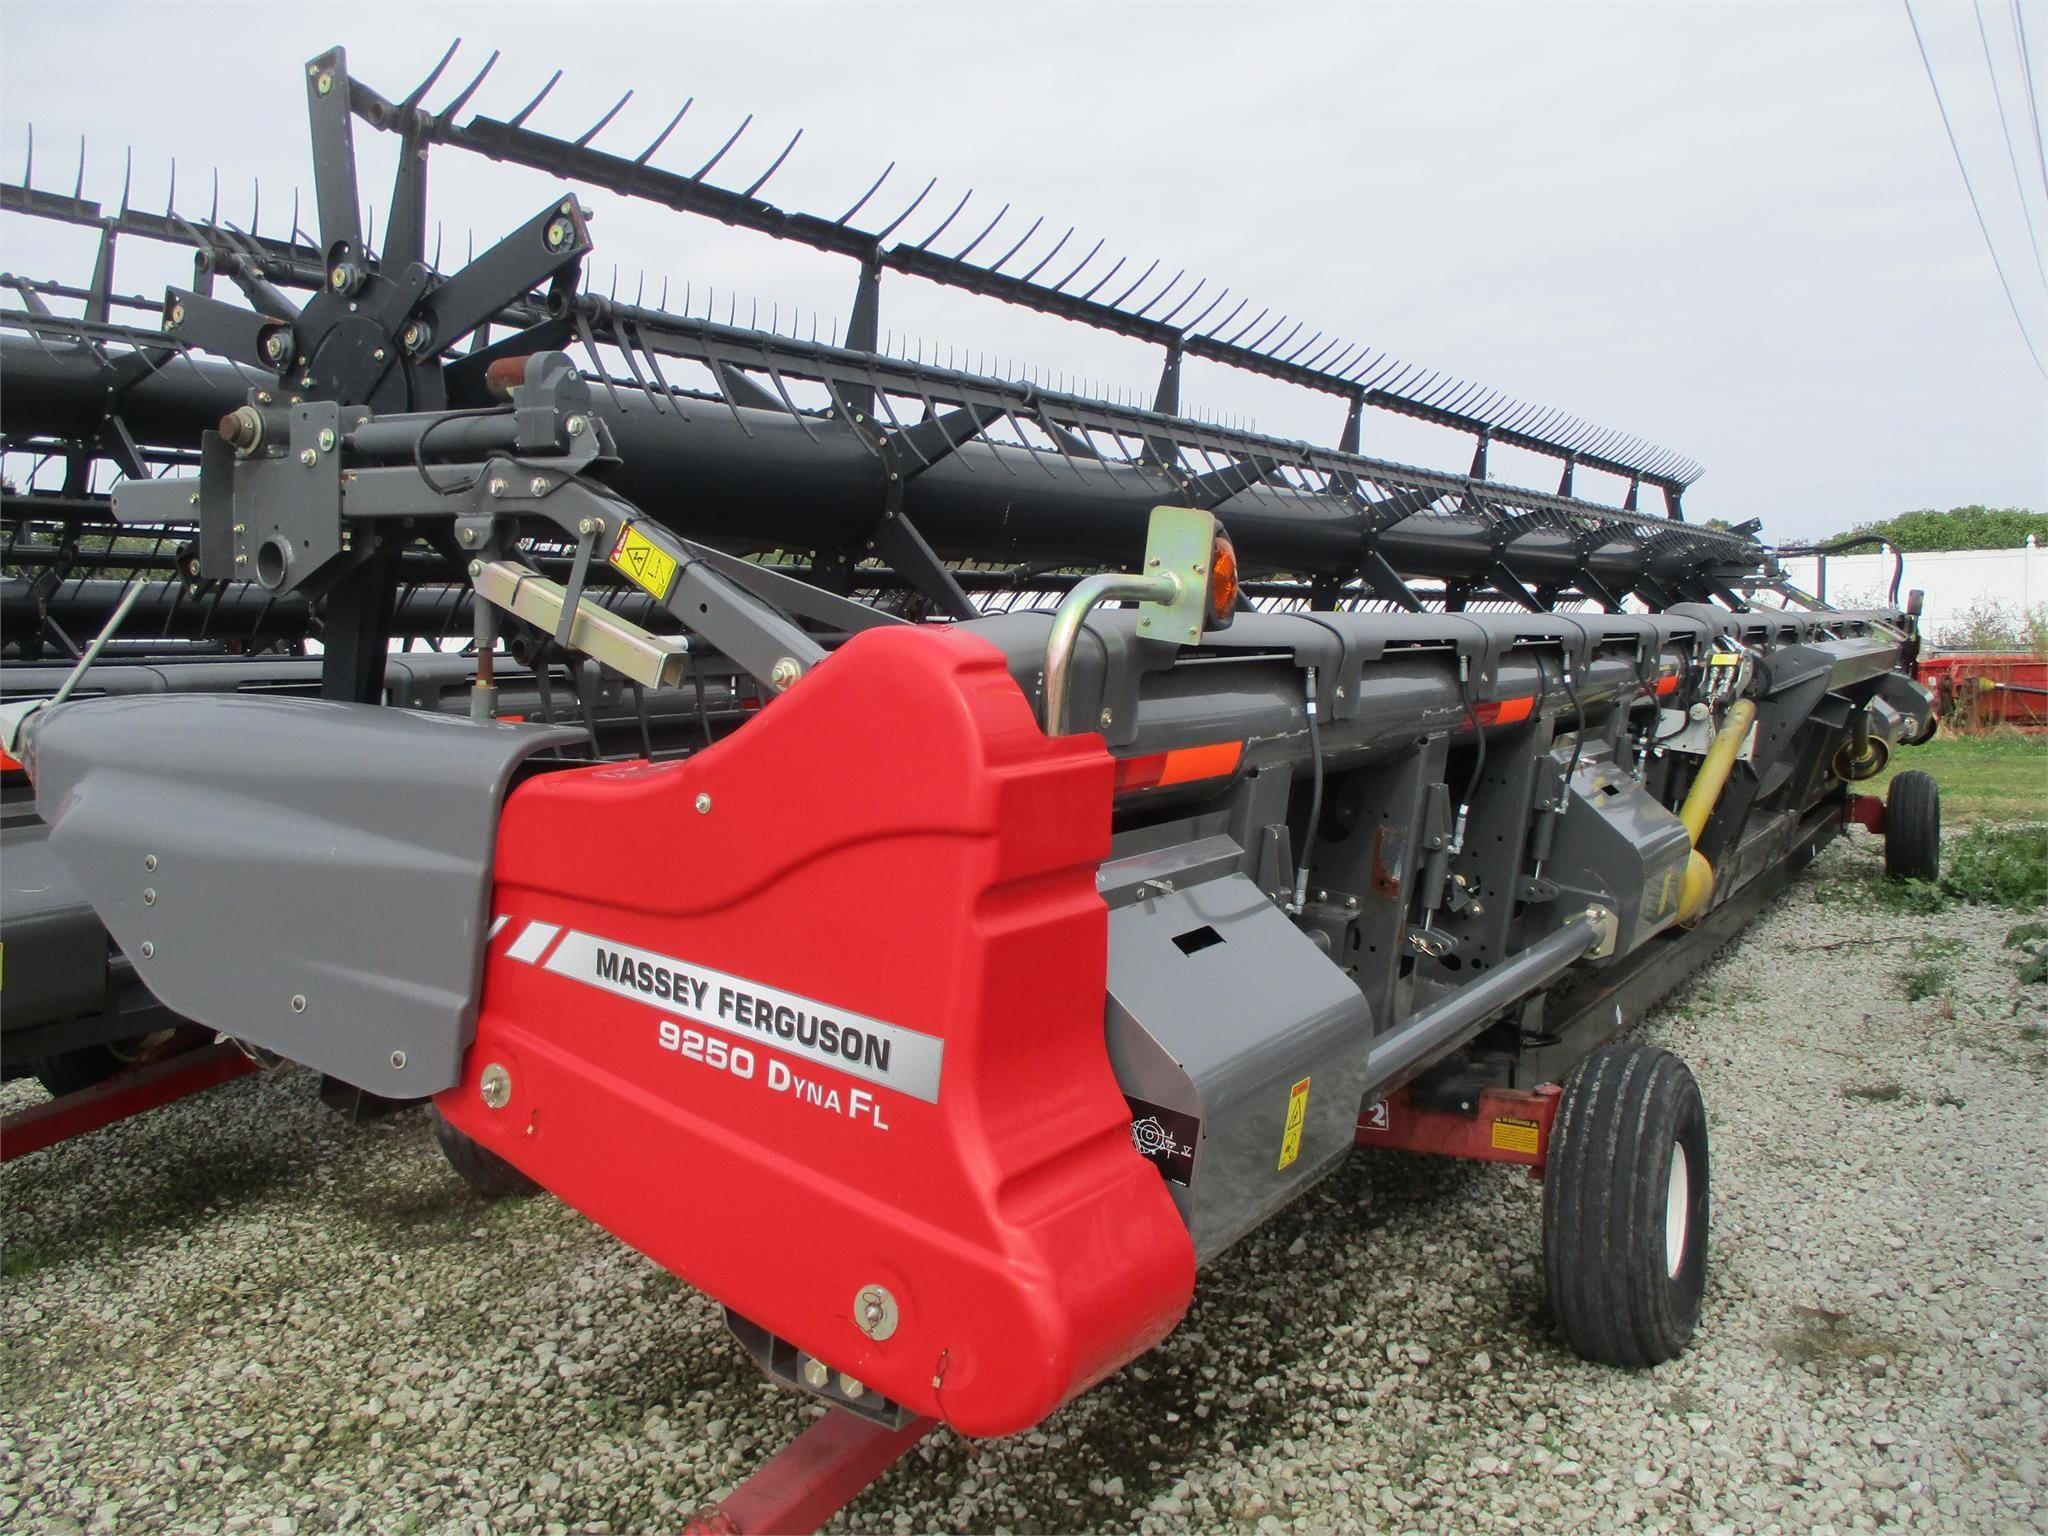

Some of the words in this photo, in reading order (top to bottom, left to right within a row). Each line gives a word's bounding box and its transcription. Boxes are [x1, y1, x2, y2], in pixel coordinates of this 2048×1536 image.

[596, 947, 709, 1011] MASSEY
[718, 986, 891, 1072] FERGUSON
[658, 1020, 755, 1080] 9250
